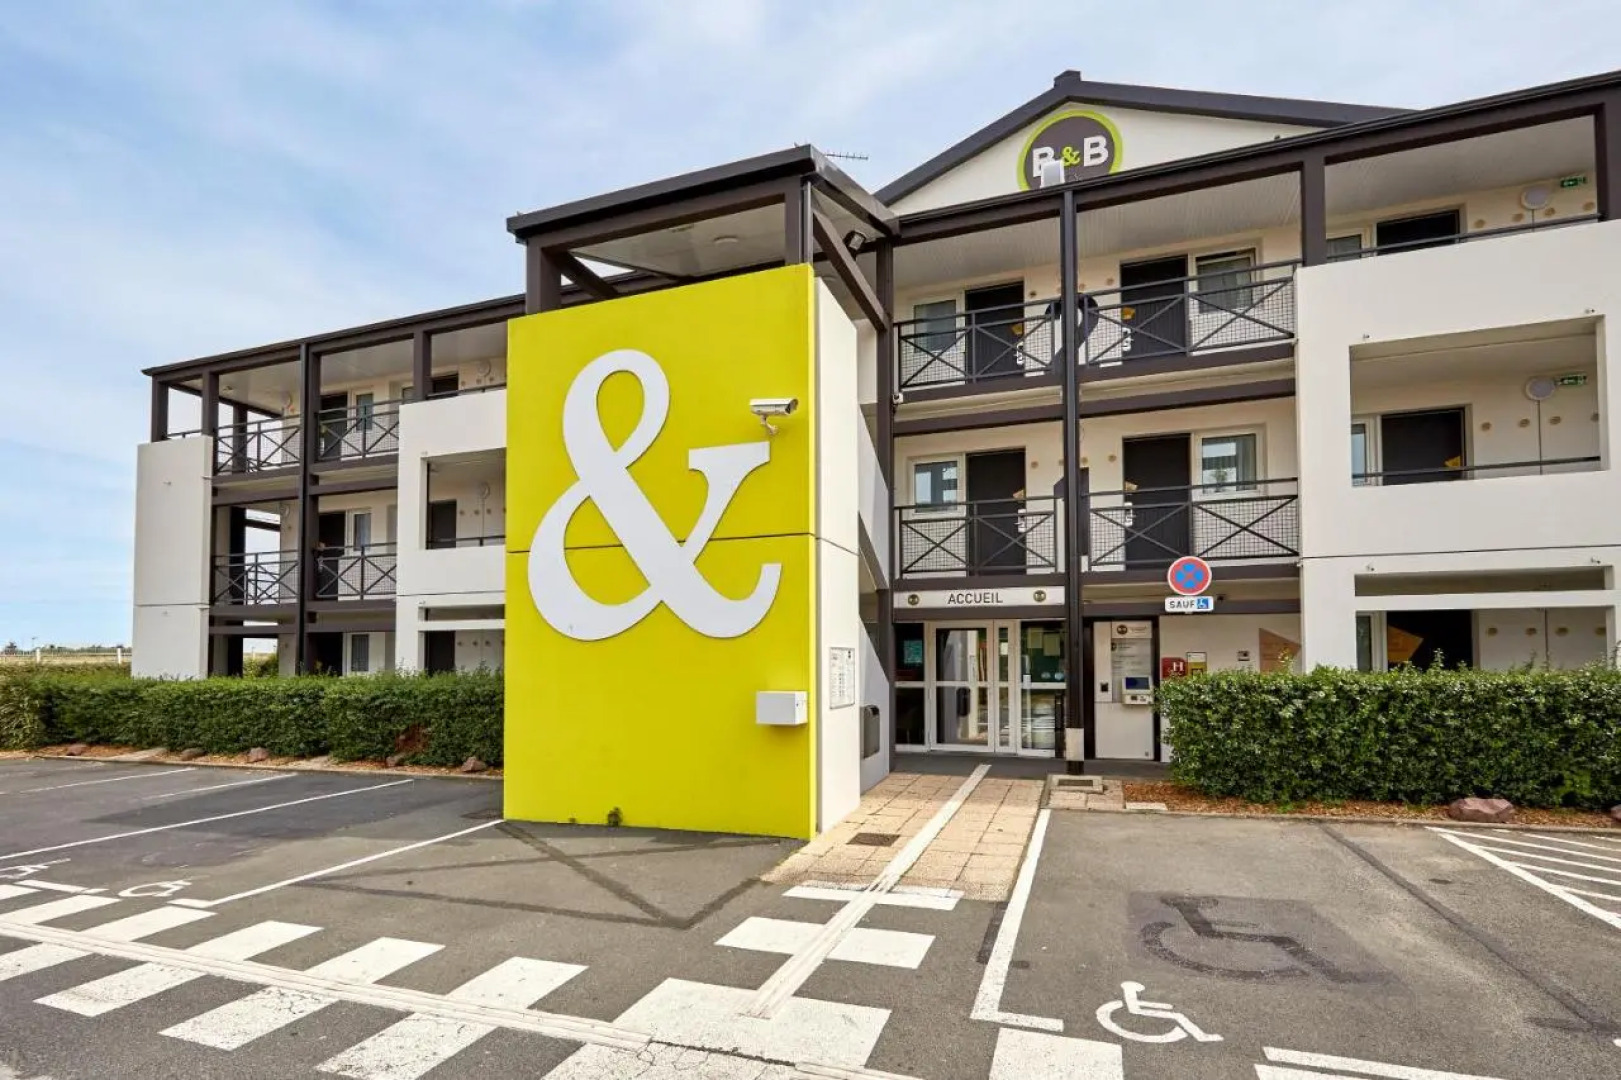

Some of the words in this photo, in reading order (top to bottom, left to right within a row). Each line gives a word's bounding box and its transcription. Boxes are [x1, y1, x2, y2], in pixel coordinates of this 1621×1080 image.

[528, 349, 781, 641] &
[947, 592, 1003, 604] ACCUEIL
[1169, 600, 1195, 608] SAUF
